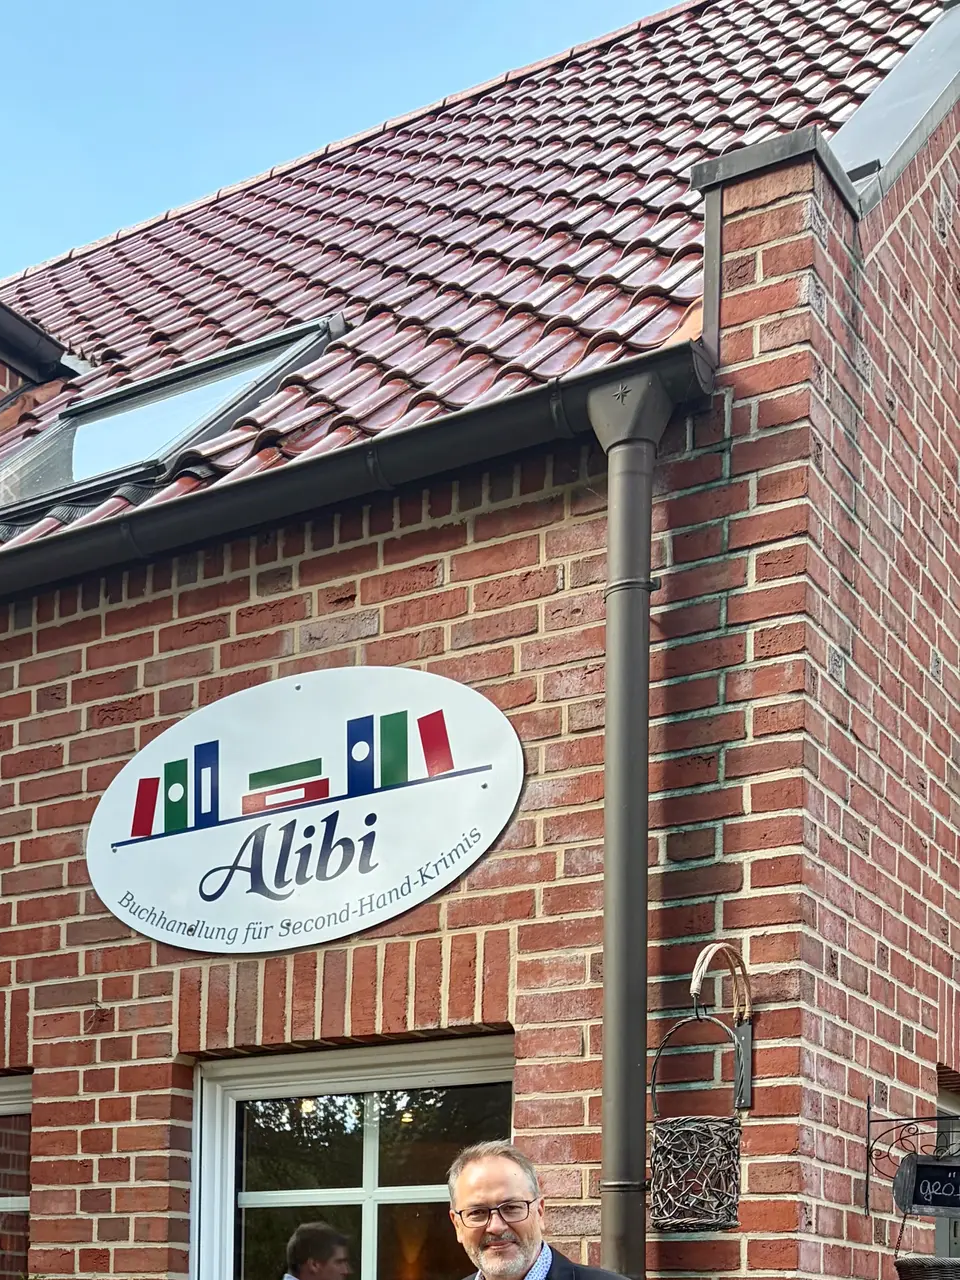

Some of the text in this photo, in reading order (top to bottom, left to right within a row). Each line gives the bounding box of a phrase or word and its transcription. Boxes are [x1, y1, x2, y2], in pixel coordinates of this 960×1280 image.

[117, 826, 482, 946] Buchhandlung für Second-Hand-Krimis
[199, 810, 380, 902] Alibi
[920, 1172, 960, 1201] geö
